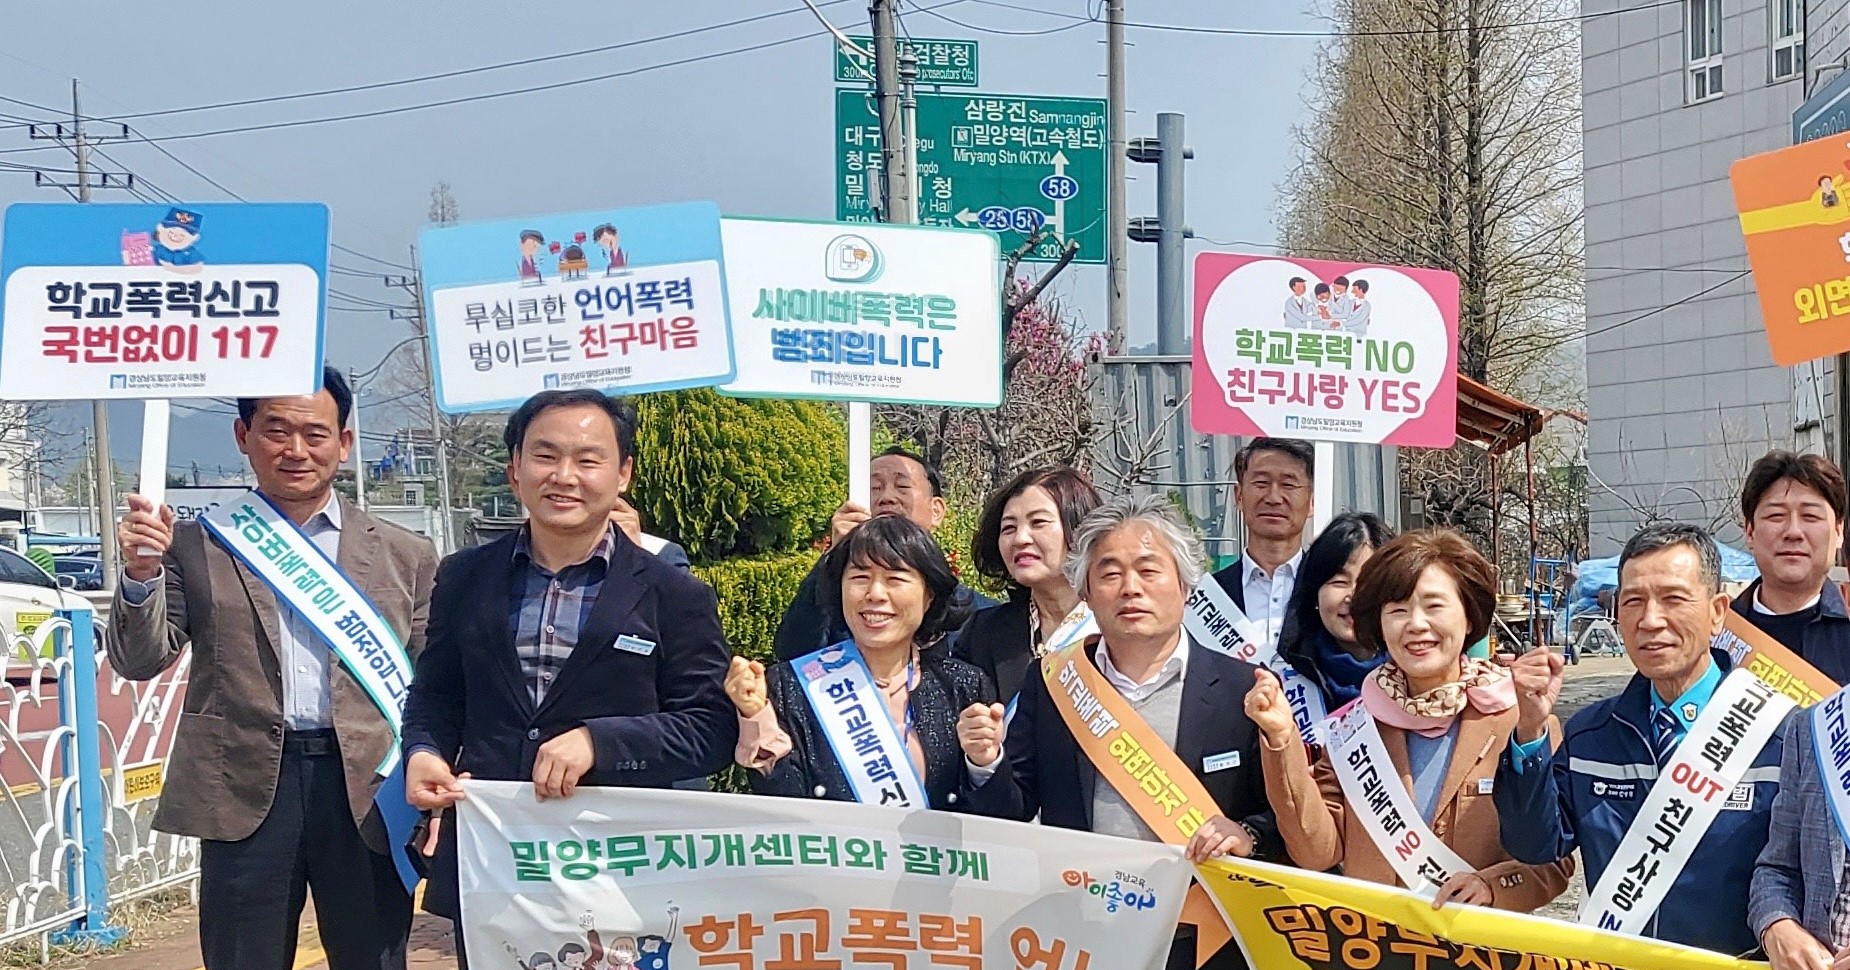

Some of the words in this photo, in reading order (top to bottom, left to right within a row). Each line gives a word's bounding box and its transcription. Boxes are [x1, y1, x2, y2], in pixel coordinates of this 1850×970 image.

[843, 67, 869, 79] 300
[965, 99, 1026, 122] 삼랑진
[1029, 109, 1104, 128] Samnangjin
[845, 126, 880, 147] 대구
[973, 124, 1104, 149] 밀양역(고속철도)
[954, 148, 996, 166] Miryang
[998, 149, 1018, 164] Stn
[1019, 150, 1050, 165] (KTX)
[929, 199, 953, 213] Hall
[1048, 180, 1070, 196] 58
[985, 210, 1008, 228] 25
[46, 280, 280, 319] 학교폭력신고
[465, 293, 567, 333] 무심코한
[574, 277, 695, 321] 언어폭력
[752, 287, 957, 330] 사이버폭력은
[42, 324, 199, 363] 국번없이
[211, 325, 280, 359] 117
[469, 334, 572, 372] 멍이드는
[578, 316, 700, 359] 친구마음
[770, 328, 943, 369] 범죄입니다
[1235, 328, 1353, 371] 학교폭력
[1364, 338, 1415, 374] NO
[1227, 367, 1348, 411] 친구사랑
[1357, 378, 1421, 415] YES
[230, 503, 345, 615] 사이버폭력은
[1057, 659, 1120, 739] 학교폭력
[1109, 731, 1189, 816] 외면하지
[1347, 742, 1407, 837] 학교폭력
[1394, 829, 1421, 861] NO
[1671, 762, 1724, 803] OUT
[509, 831, 888, 883] 밀양무지개센터와
[899, 841, 989, 882] 함께
[1612, 796, 1694, 912] 친구사랑
[1061, 869, 1156, 913] 아이좋아
[1115, 869, 1146, 889] 경남교육
[1598, 909, 1623, 932] IN
